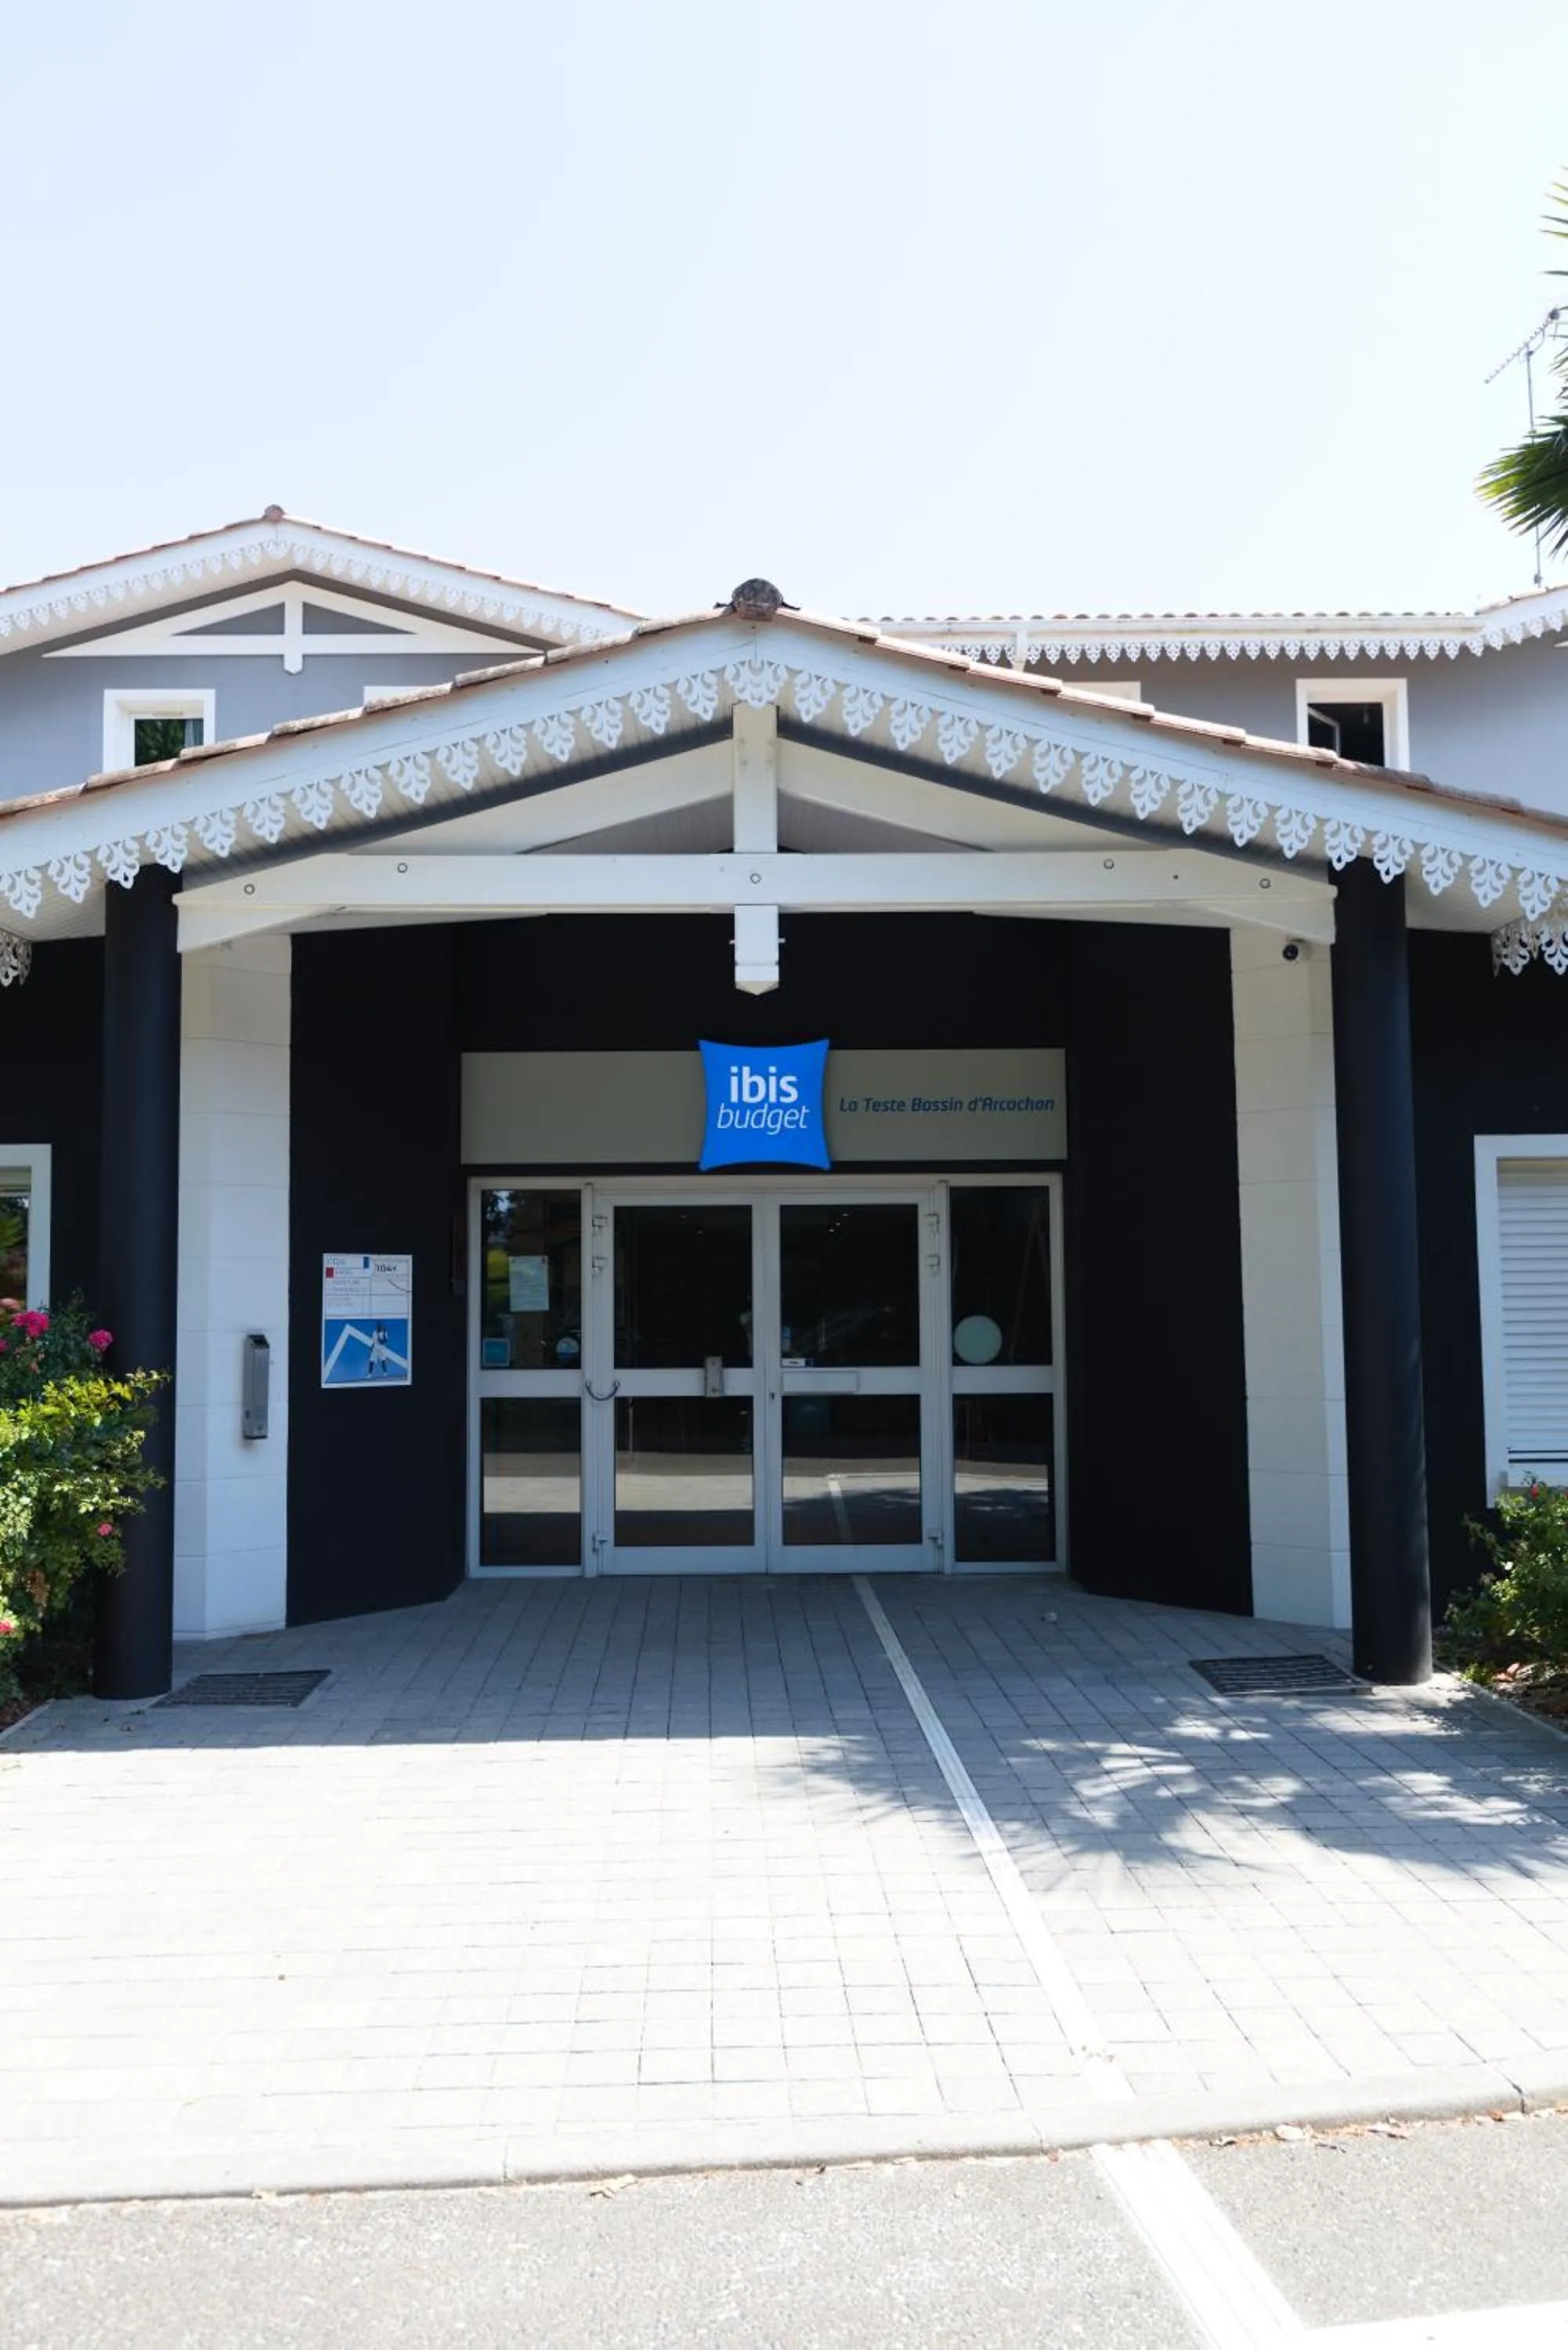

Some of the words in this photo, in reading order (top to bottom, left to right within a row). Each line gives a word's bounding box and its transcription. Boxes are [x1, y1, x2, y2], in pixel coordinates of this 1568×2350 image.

[730, 1066, 798, 1103] ibis
[717, 1103, 810, 1135] budget
[840, 1097, 858, 1112] La
[863, 1097, 906, 1112] Teste
[911, 1097, 963, 1112] Bassin
[968, 1097, 1054, 1112] d'Arcachon
